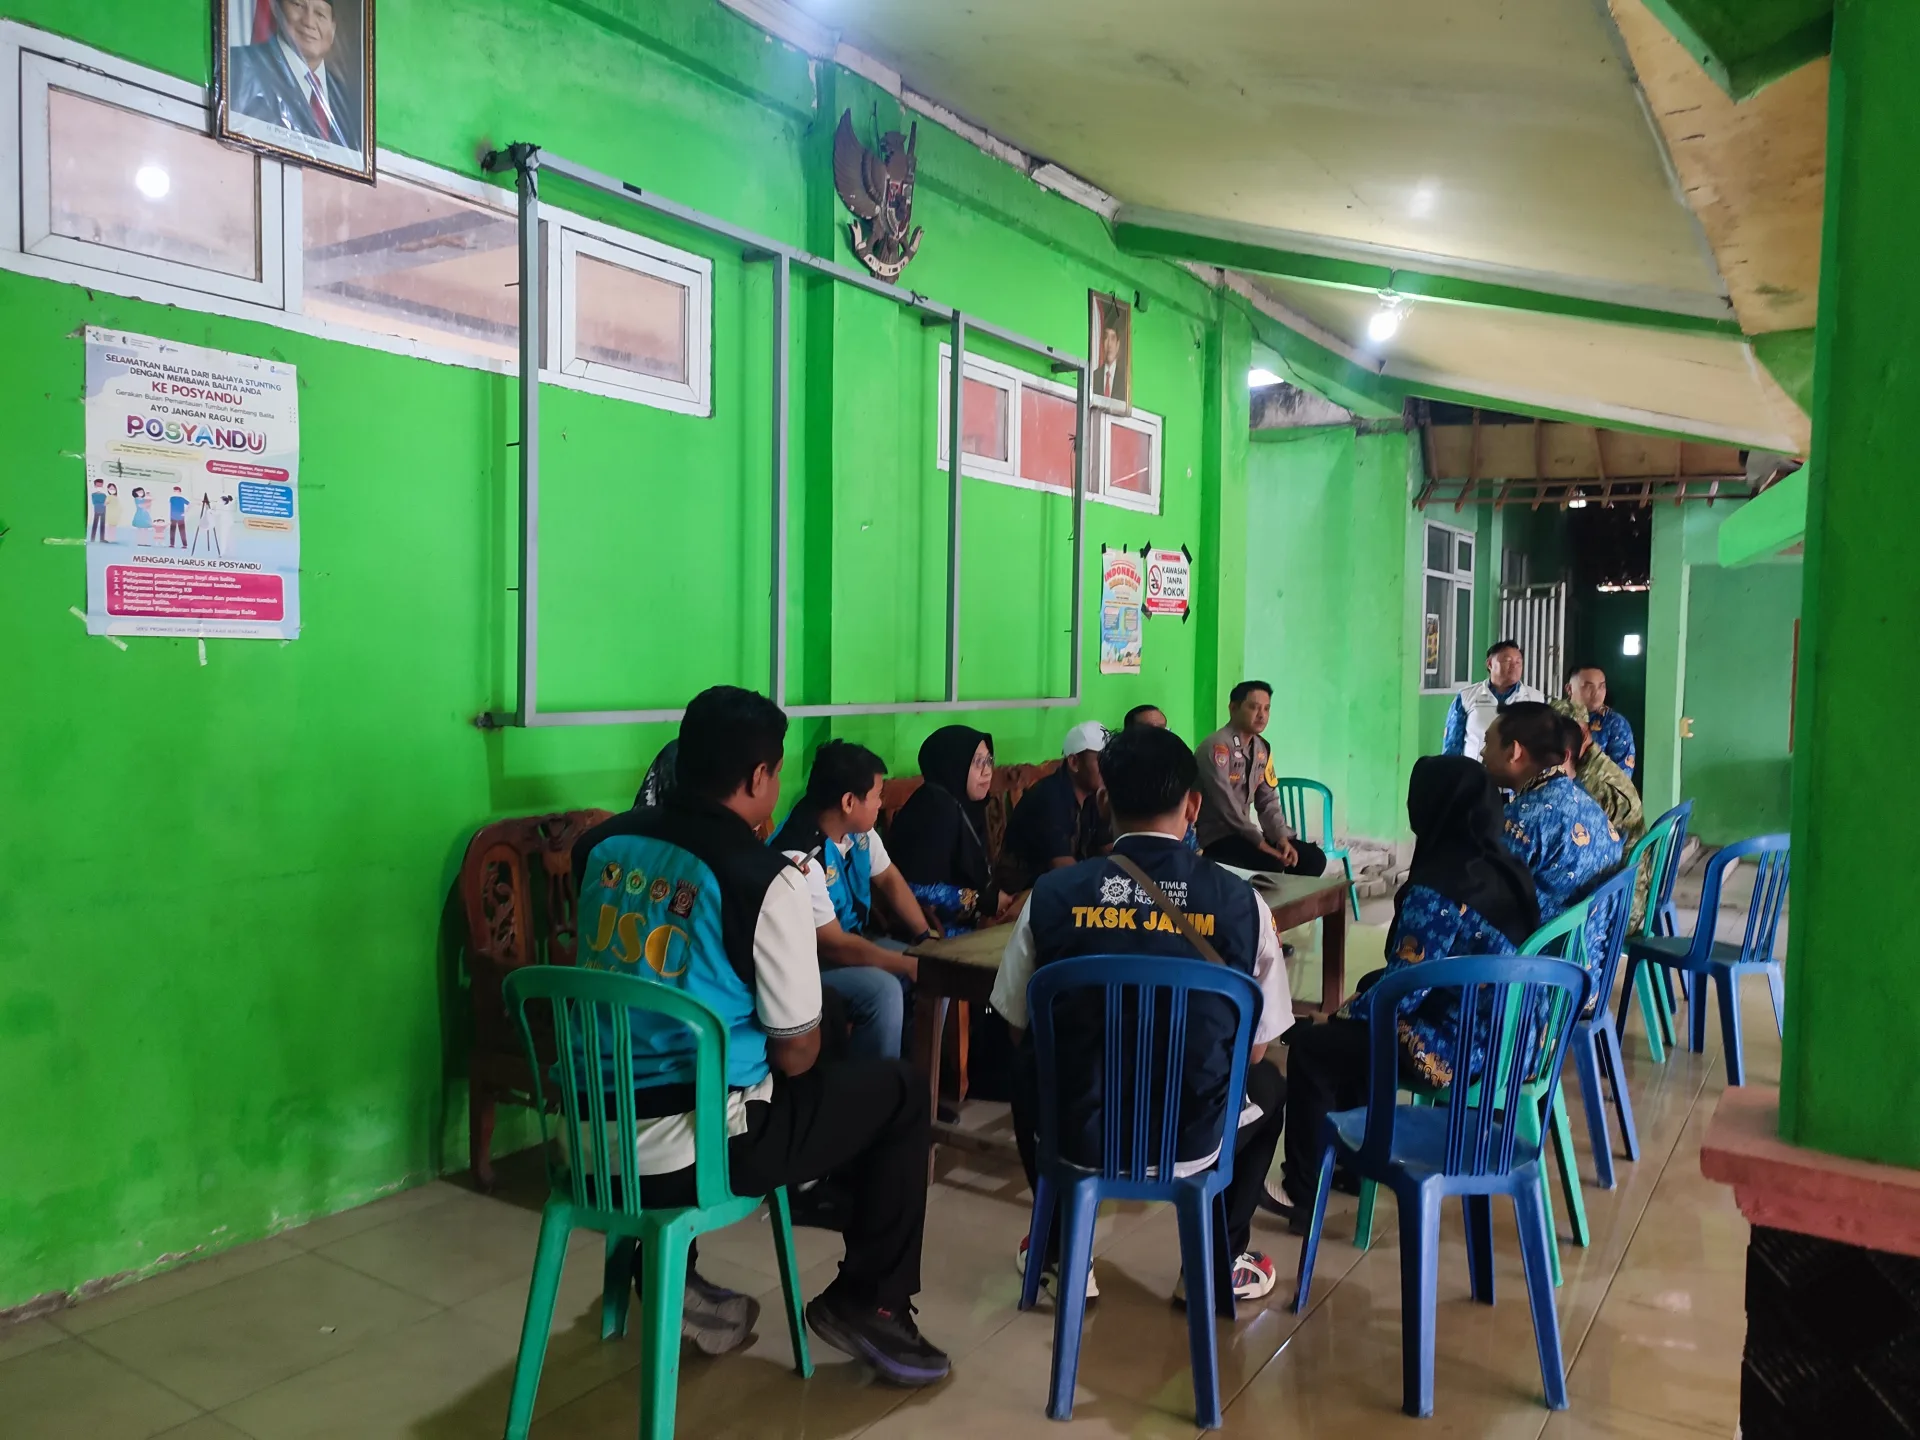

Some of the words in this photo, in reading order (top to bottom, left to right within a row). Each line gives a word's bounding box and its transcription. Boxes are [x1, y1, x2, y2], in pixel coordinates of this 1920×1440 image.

[105, 353, 161, 370] SELAMATKAN
[163, 364, 190, 375] BALITA
[191, 369, 210, 379] DARI
[212, 372, 244, 385] BAHAYA
[245, 379, 282, 392] STUNTING
[130, 367, 165, 380] DENGAN
[167, 373, 210, 387] MEMBAWA
[212, 382, 238, 392] BALITA
[240, 386, 262, 396] ANDA
[115, 388, 143, 399] Gerakan
[151, 381, 168, 394] KE
[171, 385, 243, 406] POSYANDU
[150, 404, 169, 414] AYO
[171, 407, 207, 419] JANGAN
[208, 412, 233, 423] RAGU
[234, 416, 245, 425] KE
[126, 414, 264, 452] POSYANDU
[132, 555, 175, 564] MENGAPA
[177, 558, 205, 567] HARUS
[207, 560, 217, 568] KE
[218, 561, 262, 570] POSYANDU
[1161, 565, 1187, 576] KAWASAN
[1166, 577, 1183, 585] TANPA
[1162, 587, 1185, 597] ROKOK
[1159, 880, 1188, 890] TIMUR
[1168, 890, 1188, 898] BARU
[1071, 906, 1137, 929] TKSK
[586, 903, 690, 978] JSC
